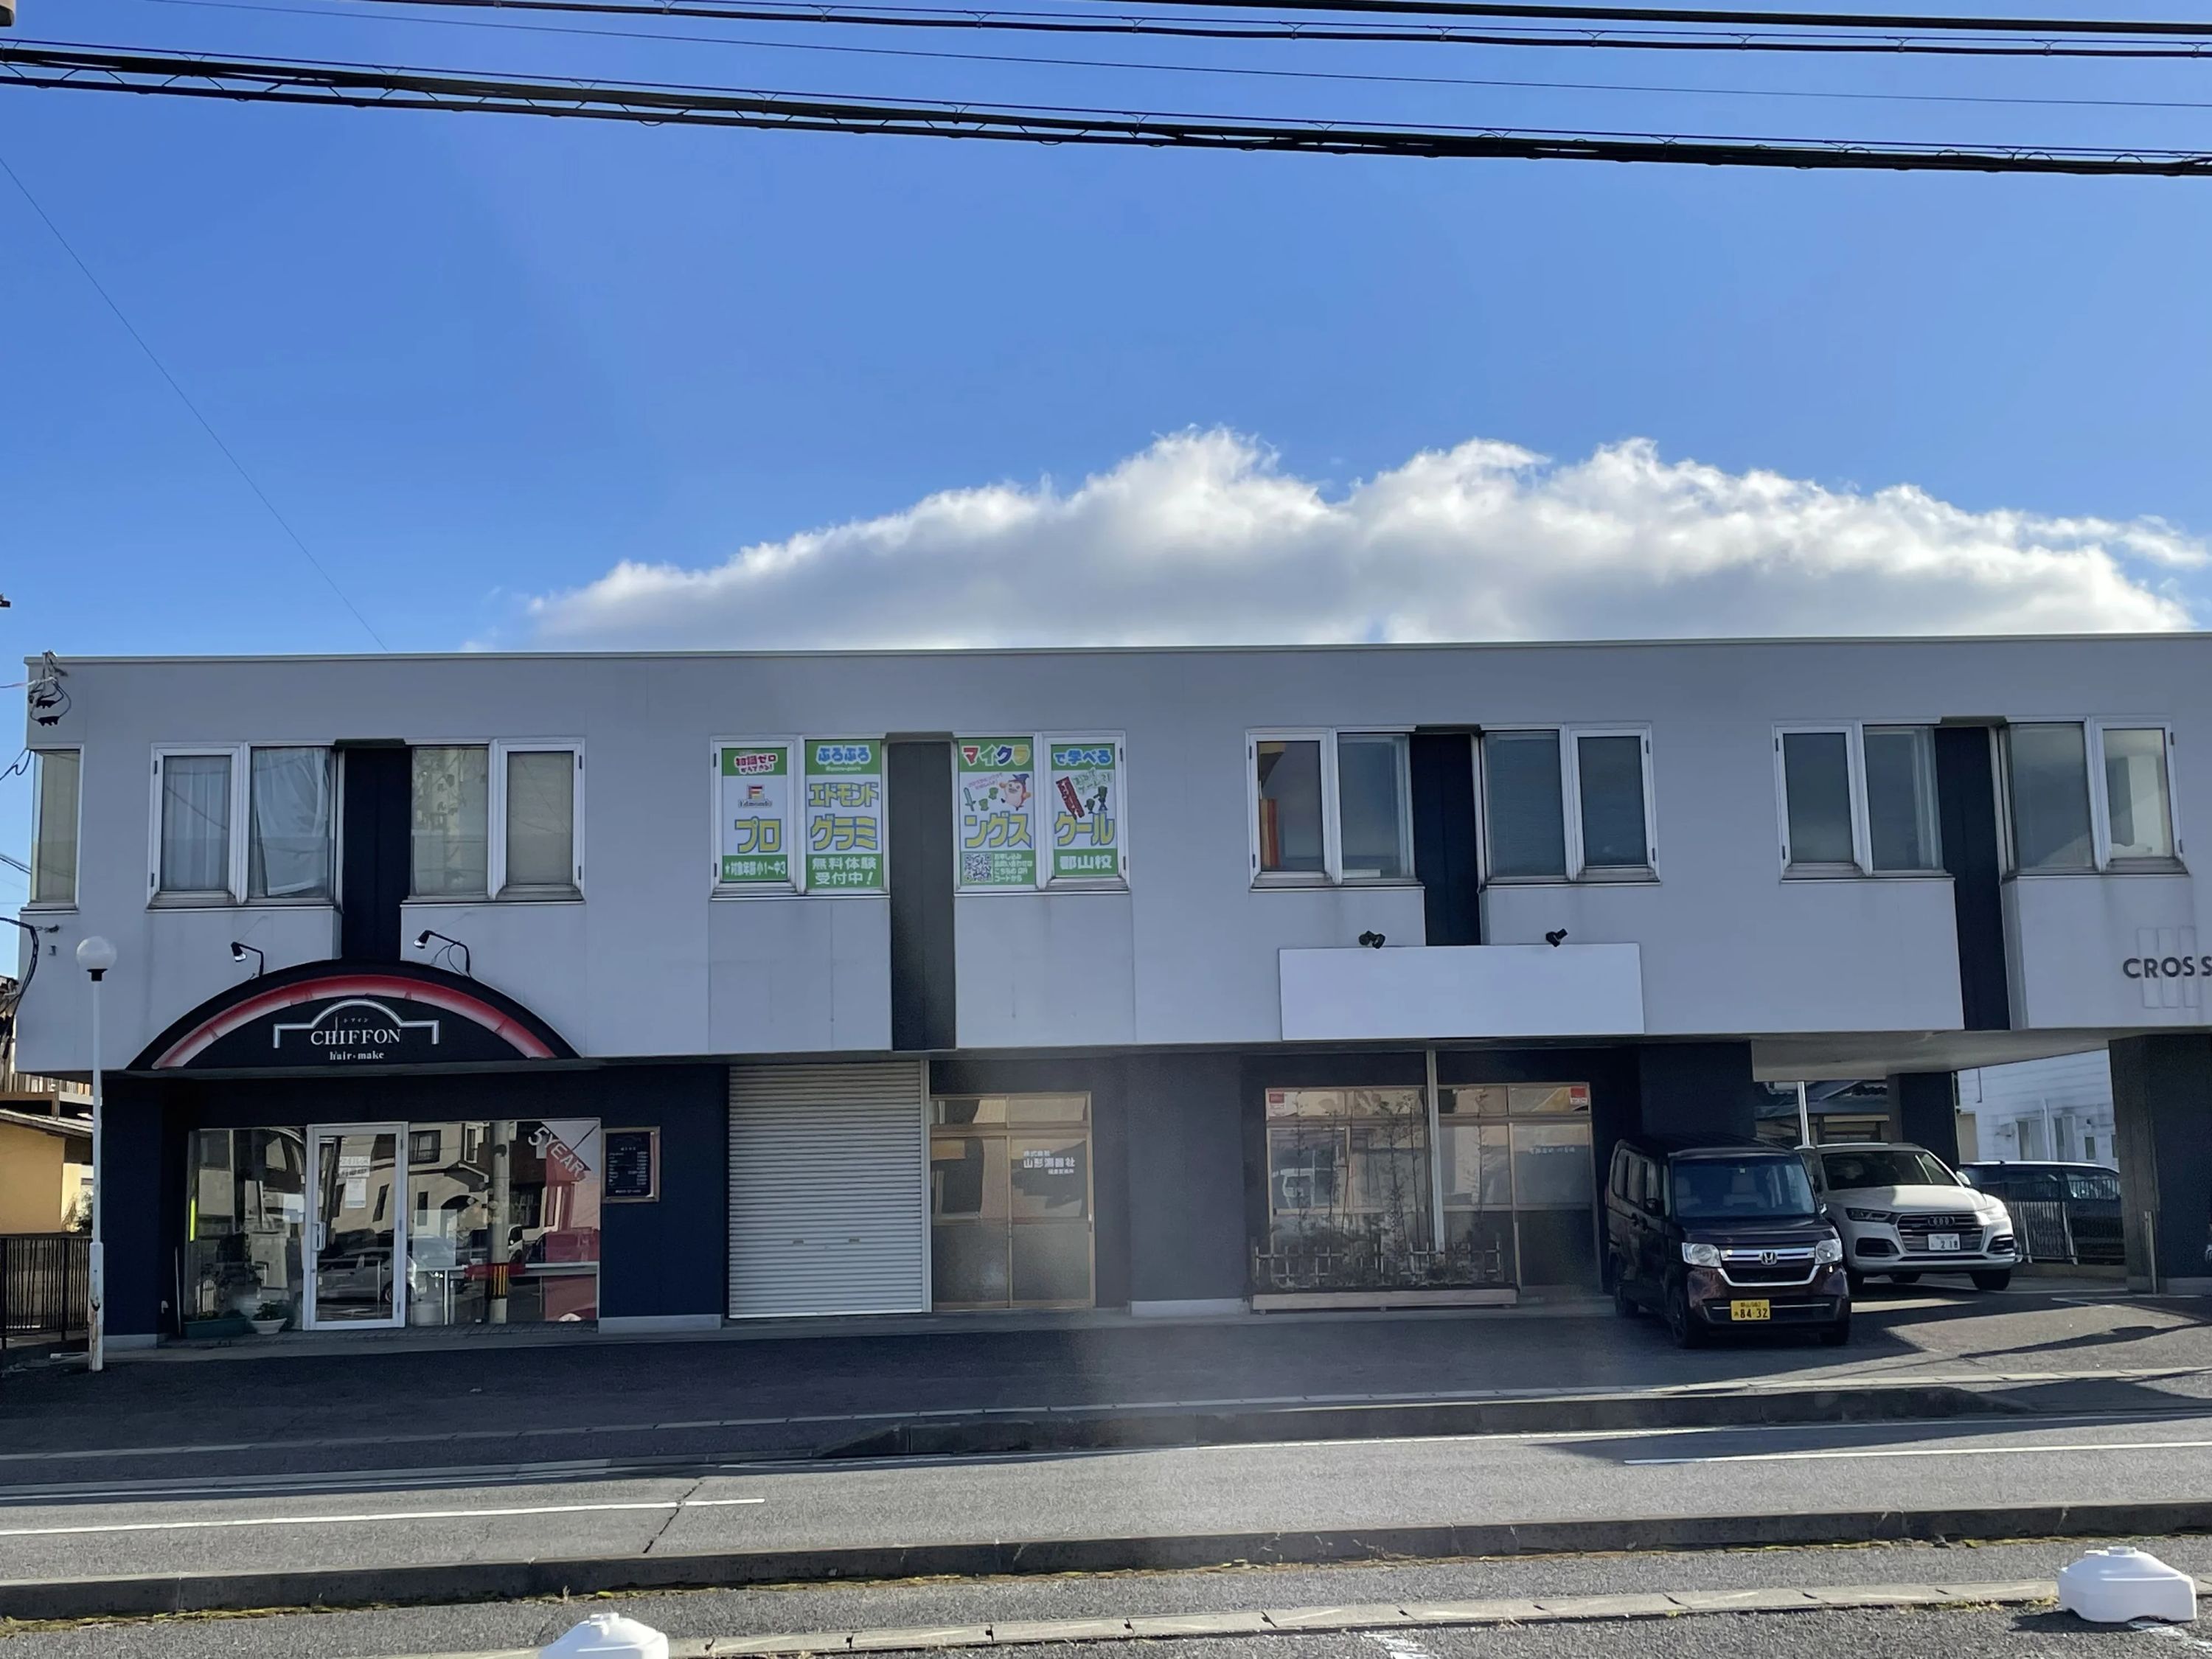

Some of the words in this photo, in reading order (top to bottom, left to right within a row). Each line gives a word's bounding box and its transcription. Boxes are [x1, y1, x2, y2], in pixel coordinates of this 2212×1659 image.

[961, 744, 1031, 766] マイクラ
[1054, 748, 1112, 765] で学べる
[808, 782, 879, 807] エドモンド
[734, 815, 782, 854] プロ
[810, 813, 877, 850] グラミ
[964, 811, 1032, 849] ングス
[1054, 811, 1115, 846] クール
[812, 857, 876, 870] 無料体験
[1060, 855, 1112, 869] 郡山校
[310, 1029, 401, 1045] CHIFFON
